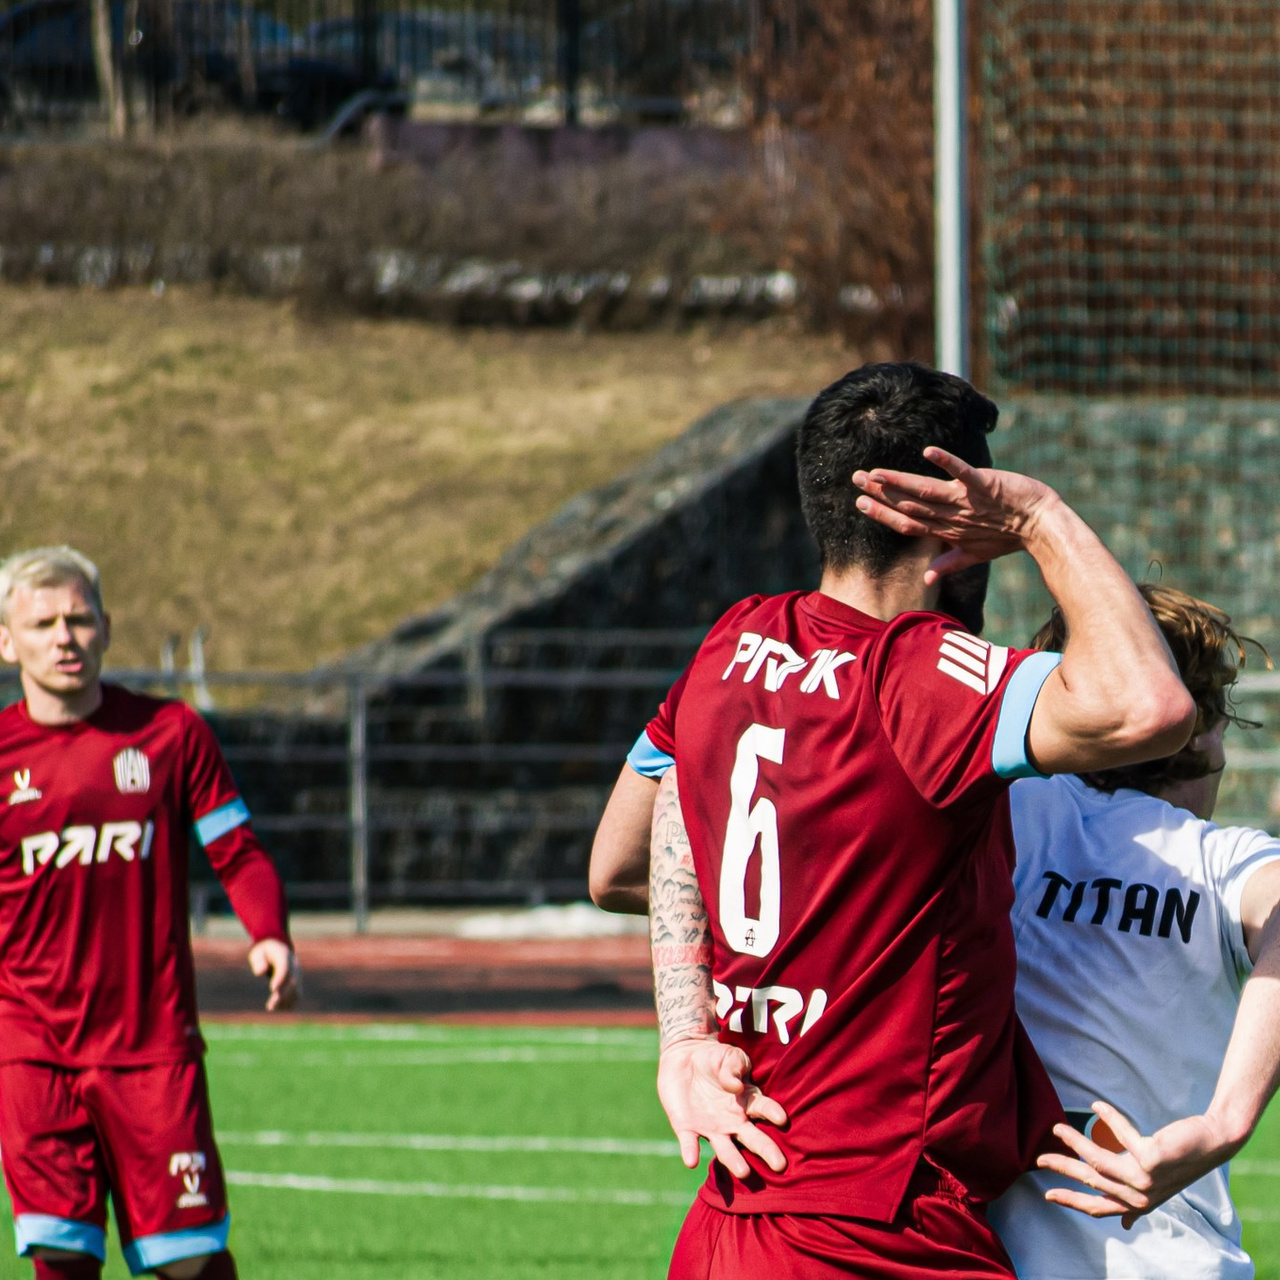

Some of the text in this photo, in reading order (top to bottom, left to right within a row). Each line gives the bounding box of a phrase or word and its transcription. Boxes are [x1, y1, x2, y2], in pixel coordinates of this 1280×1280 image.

[20, 820, 155, 876] PARI
[718, 722, 786, 958] 6
[1036, 870, 1200, 944] TITAN
